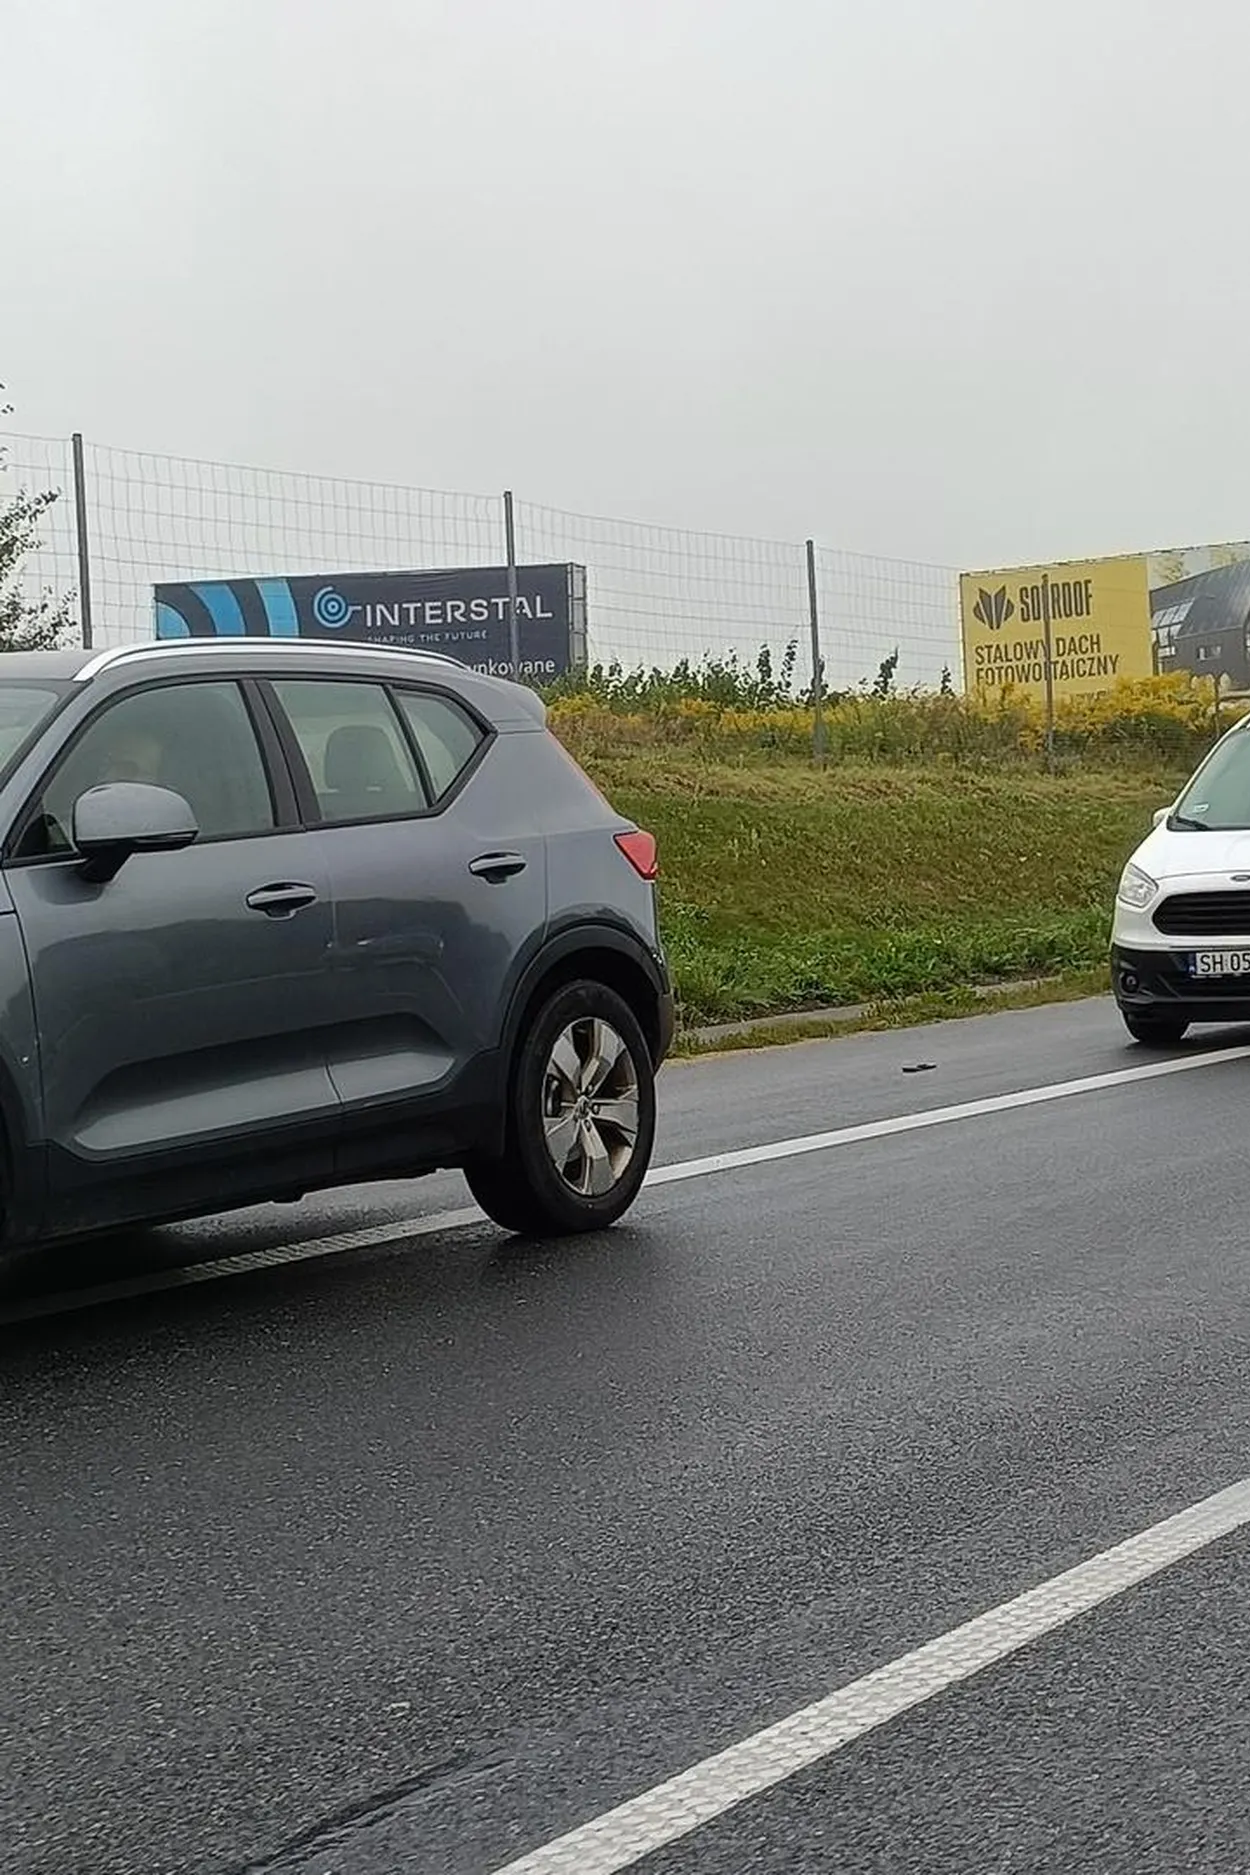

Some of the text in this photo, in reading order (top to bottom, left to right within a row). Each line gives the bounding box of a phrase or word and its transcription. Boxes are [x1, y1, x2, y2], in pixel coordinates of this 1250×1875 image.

[366, 595, 552, 627] INTERSTAL
[1019, 579, 1092, 622] SOROOF
[420, 633, 440, 642] THE
[445, 629, 487, 640] FUTURE
[1055, 633, 1100, 657] DACH
[1200, 954, 1224, 972] SH
